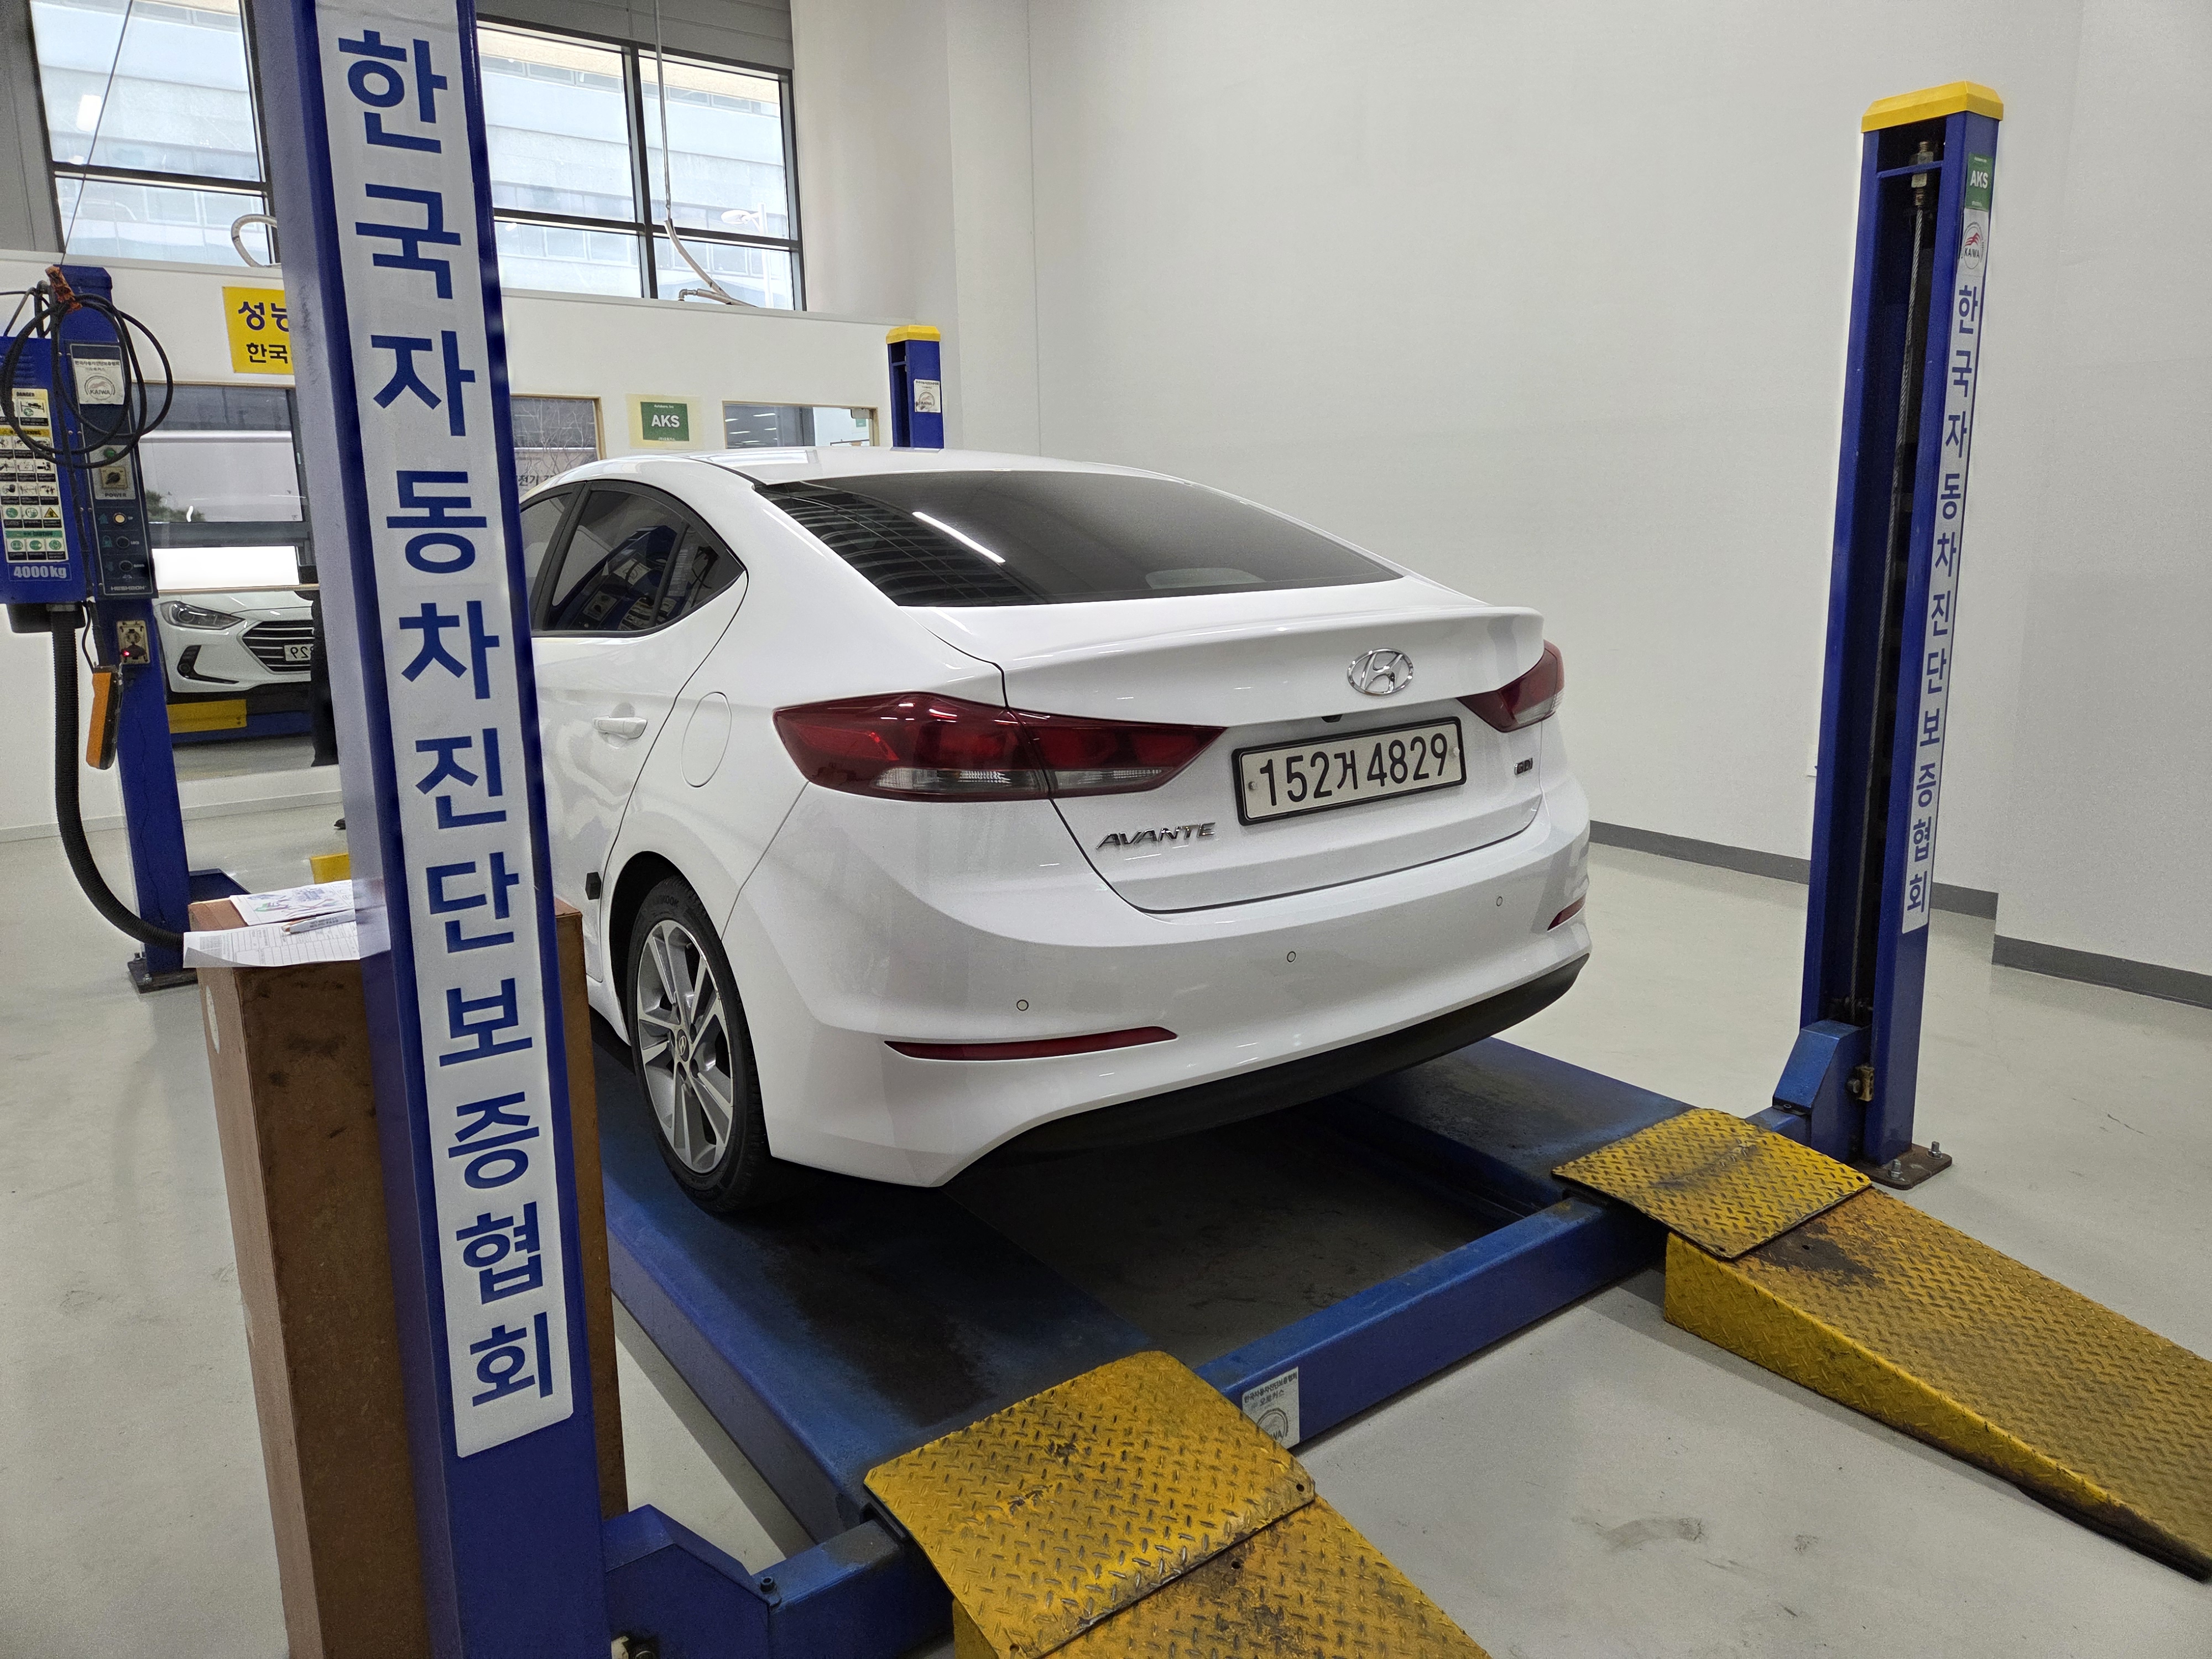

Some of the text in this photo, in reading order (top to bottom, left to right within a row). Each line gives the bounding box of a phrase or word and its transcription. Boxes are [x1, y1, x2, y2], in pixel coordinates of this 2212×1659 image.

[1970, 170, 1988, 189] AKS
[246, 342, 288, 364] 한국
[651, 415, 680, 427] AKS
[516, 474, 539, 486] 전기
[1907, 285, 1978, 912] 한국자동차진단보증협회
[338, 30, 554, 1407] 한국자동차진단보증협회
[1095, 822, 1215, 849] AVANTE
